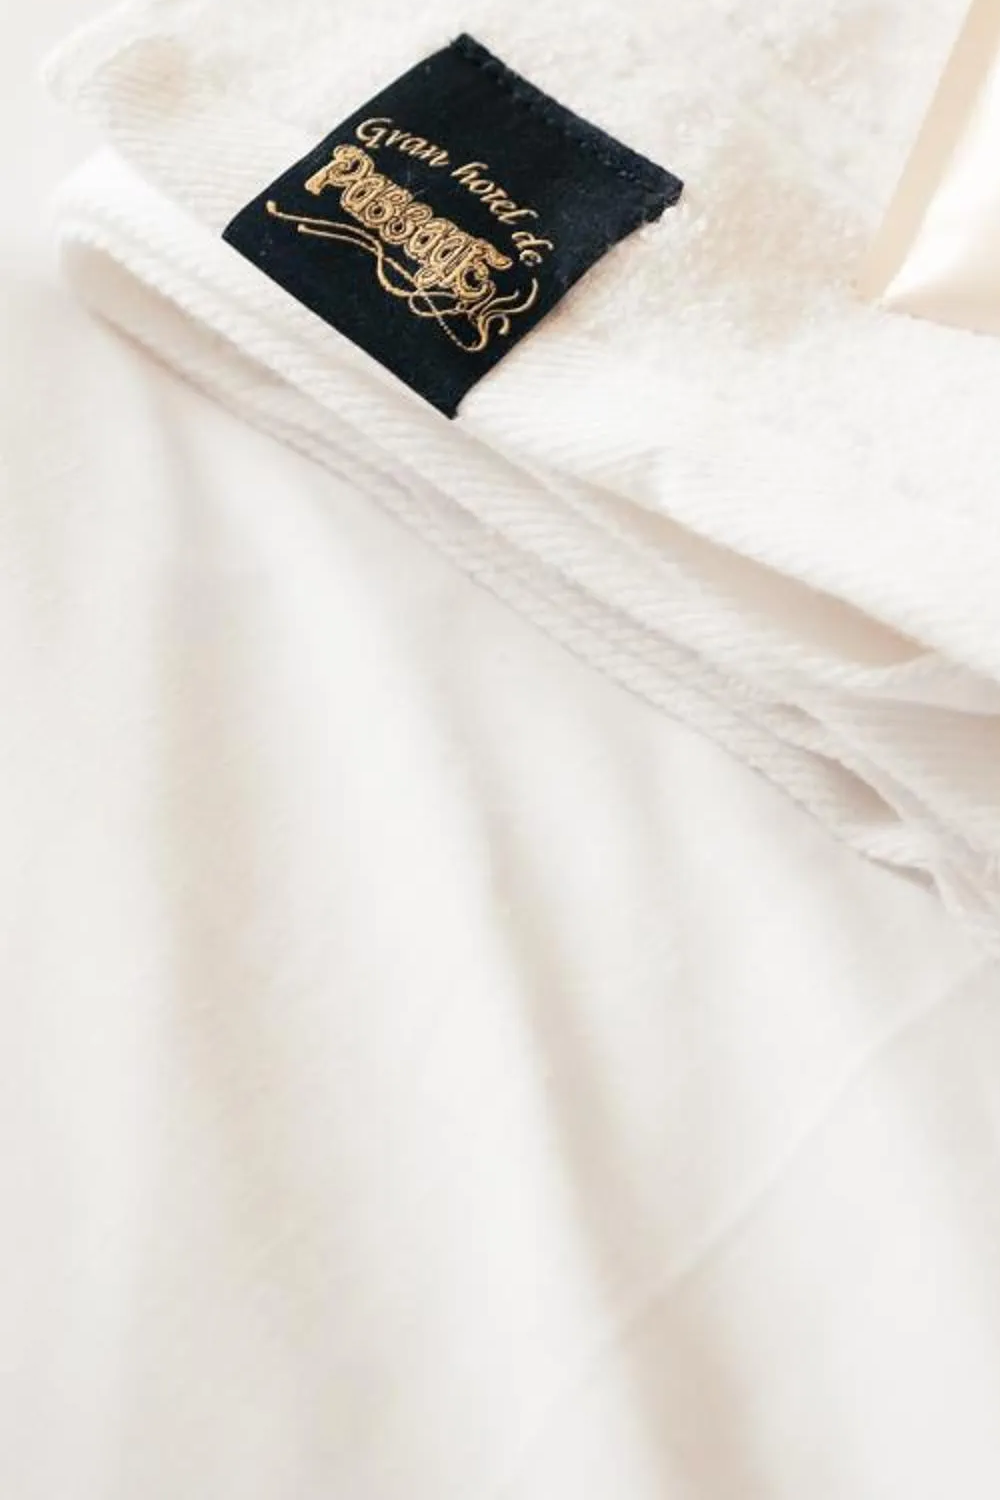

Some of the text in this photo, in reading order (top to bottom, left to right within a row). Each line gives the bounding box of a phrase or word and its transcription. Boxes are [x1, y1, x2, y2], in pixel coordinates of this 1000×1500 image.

[355, 117, 554, 267] Gran hotel de
